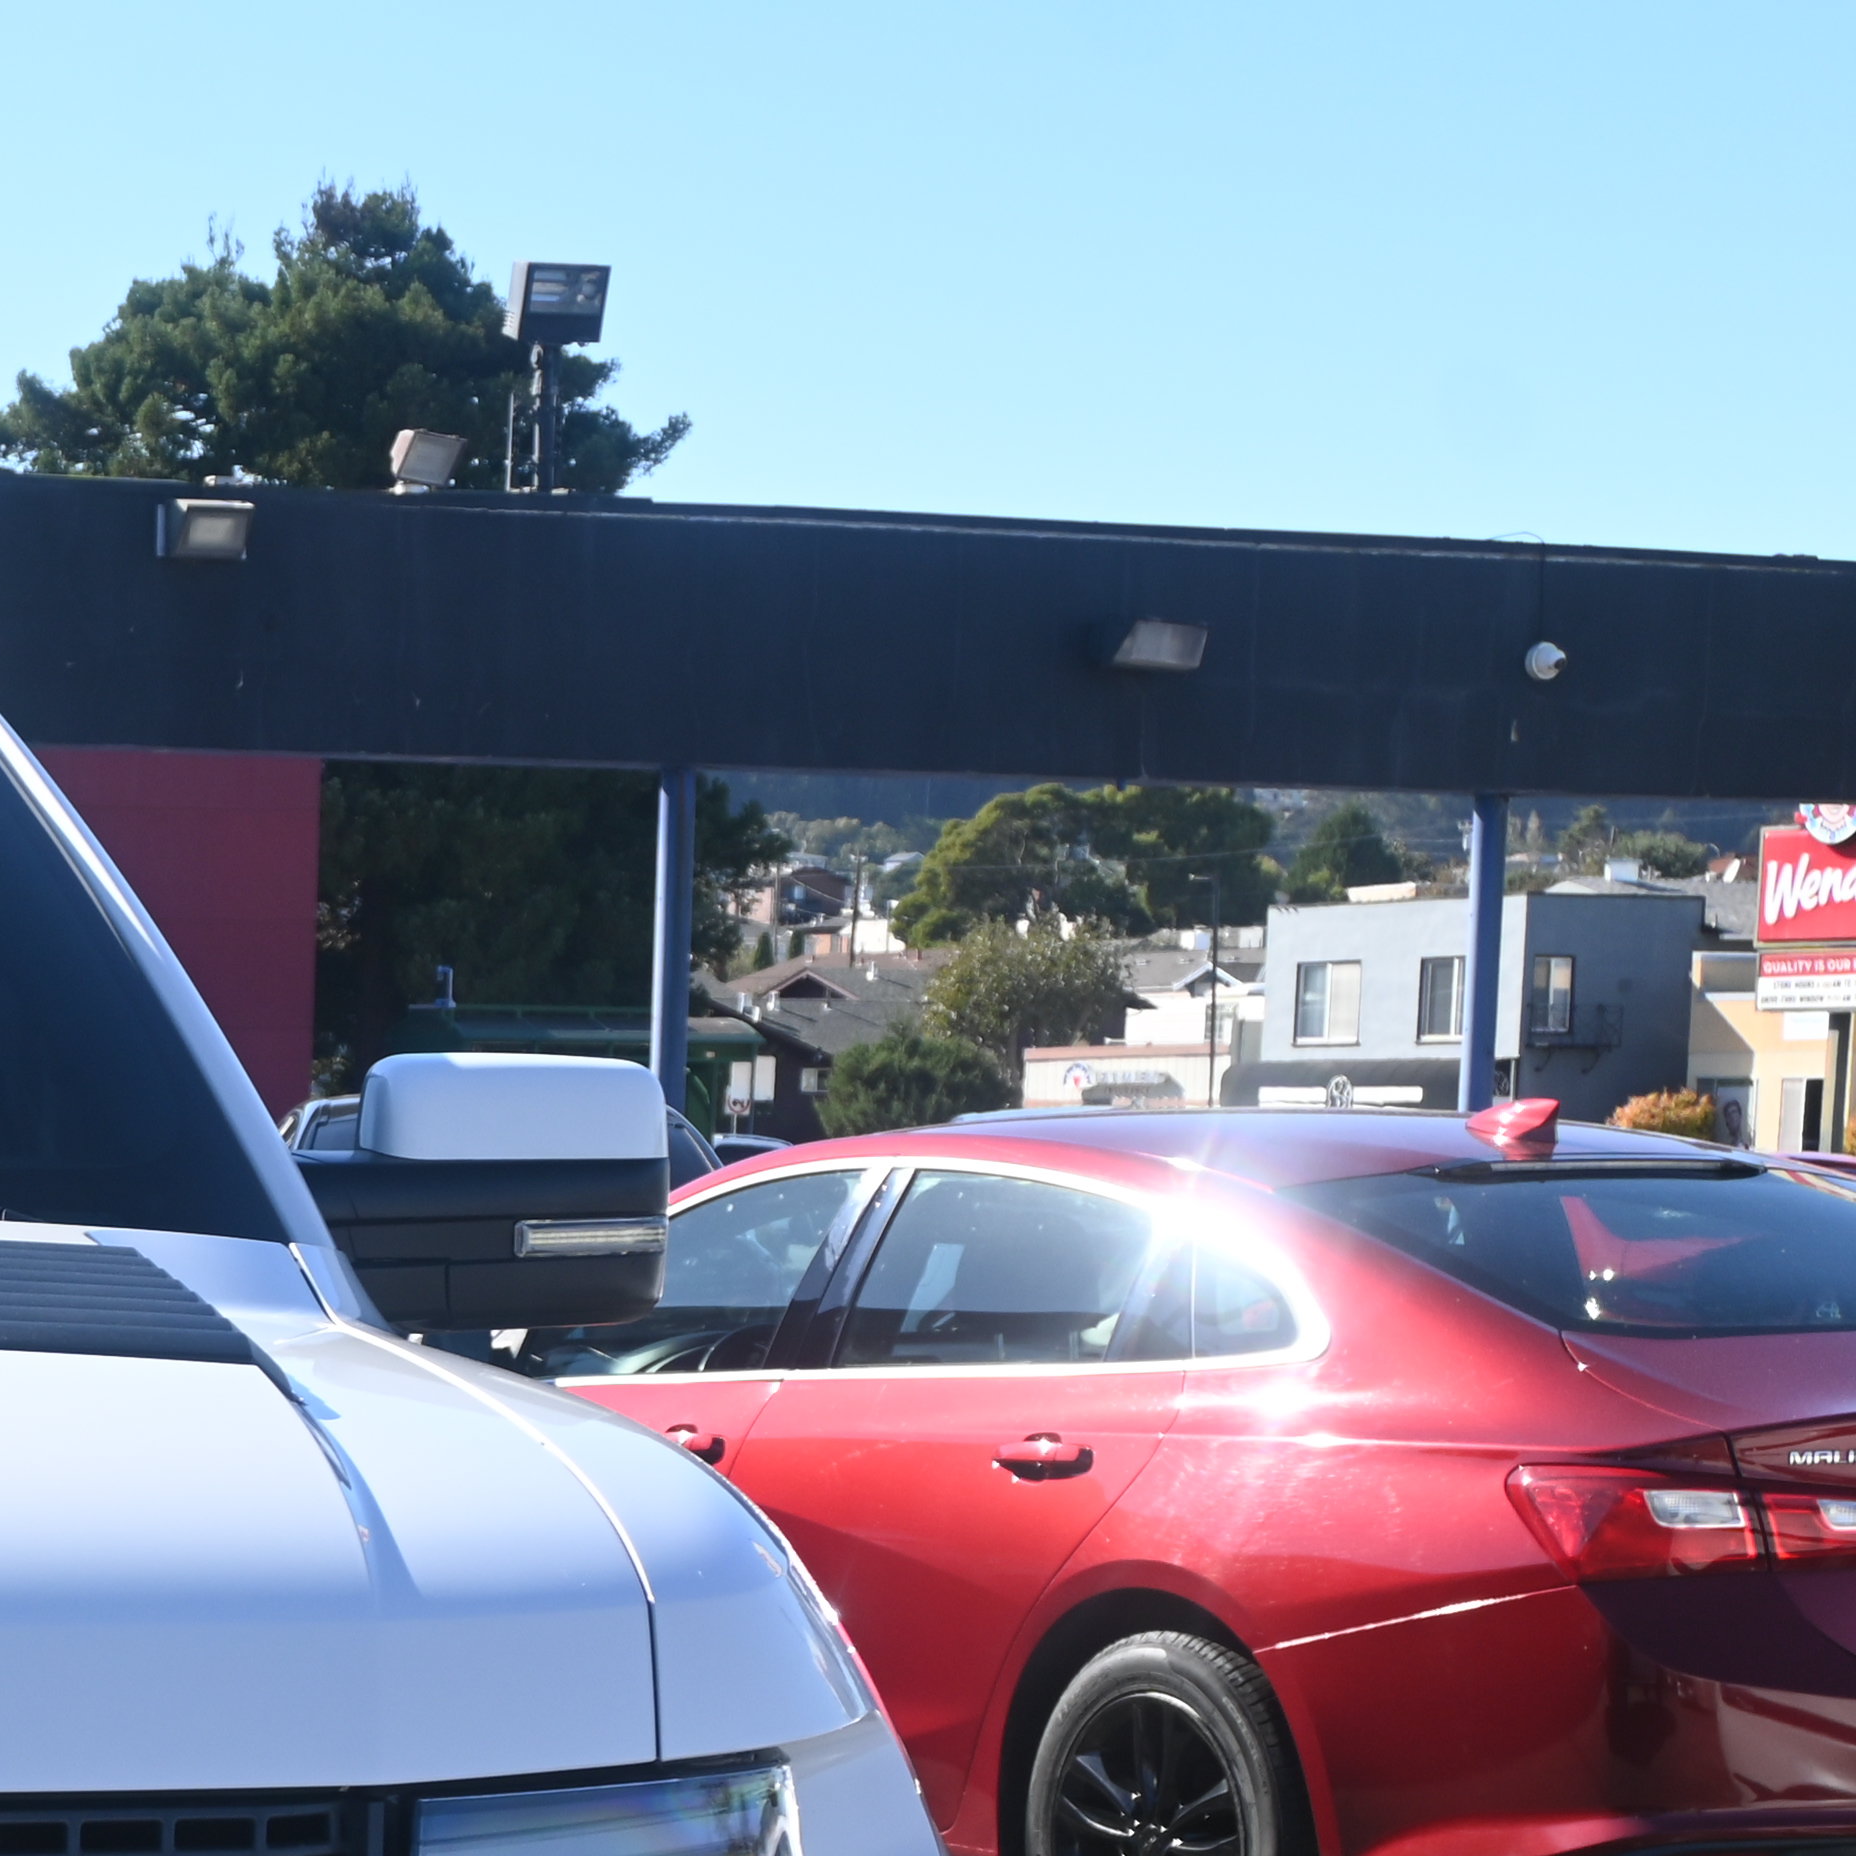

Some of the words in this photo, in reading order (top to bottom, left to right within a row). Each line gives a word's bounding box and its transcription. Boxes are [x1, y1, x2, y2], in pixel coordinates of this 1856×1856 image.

[1763, 959, 1812, 974] QUALITY
[1813, 958, 1825, 973] IS
[1826, 957, 1852, 972] OUR
[1789, 1449, 1856, 1465] MALI
